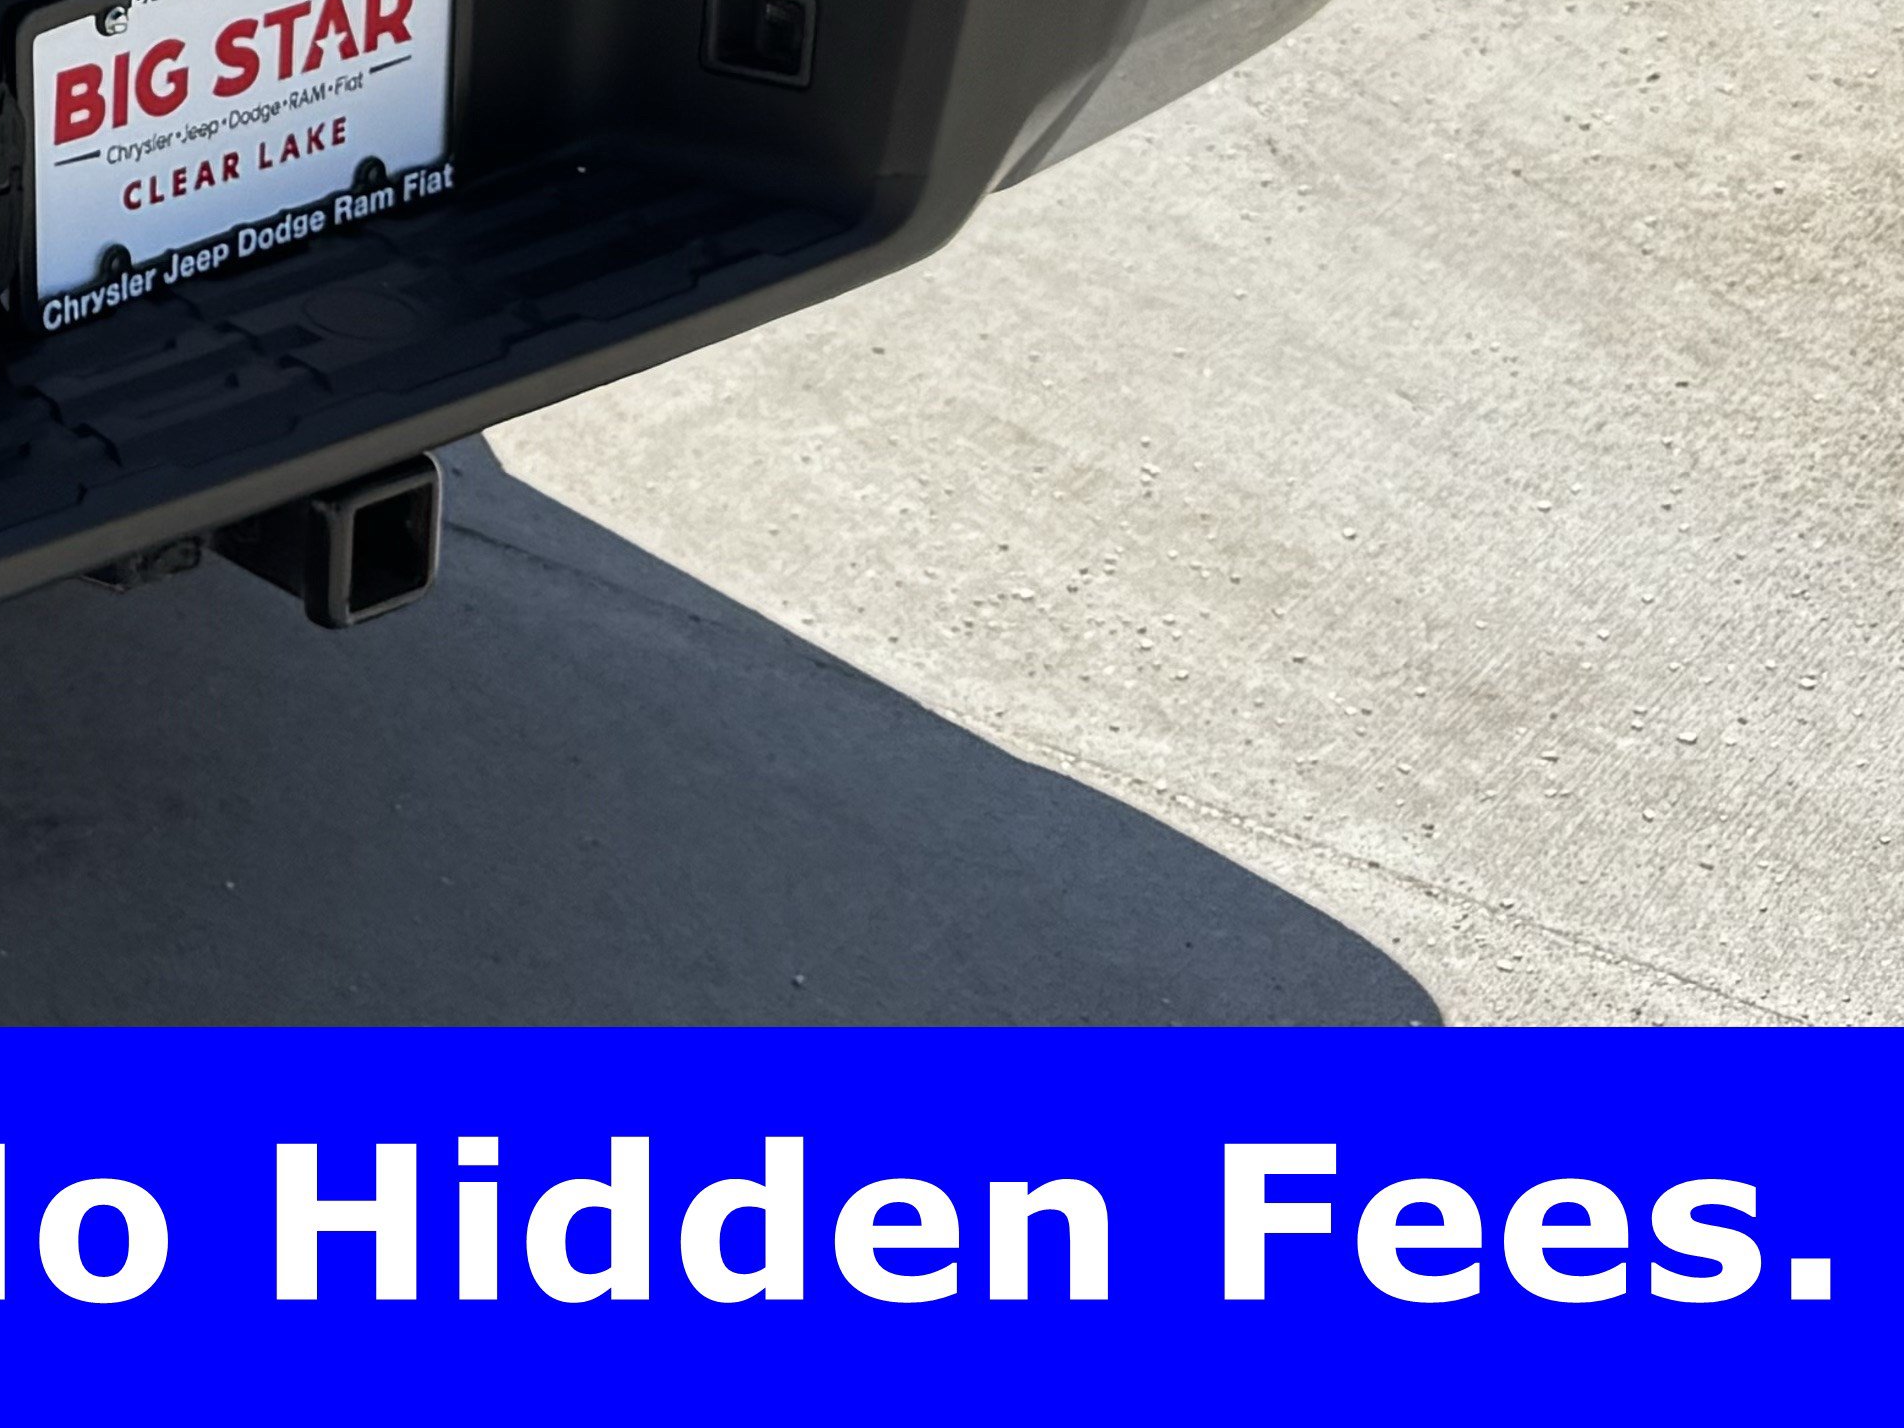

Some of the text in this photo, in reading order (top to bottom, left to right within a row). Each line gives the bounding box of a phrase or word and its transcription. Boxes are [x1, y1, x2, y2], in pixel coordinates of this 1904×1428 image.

[53, 38, 190, 146] BIG
[123, 116, 347, 211] CLEAR LAKE
[42, 161, 455, 332] Chrysler Jeep Dodge Ram Fiat
